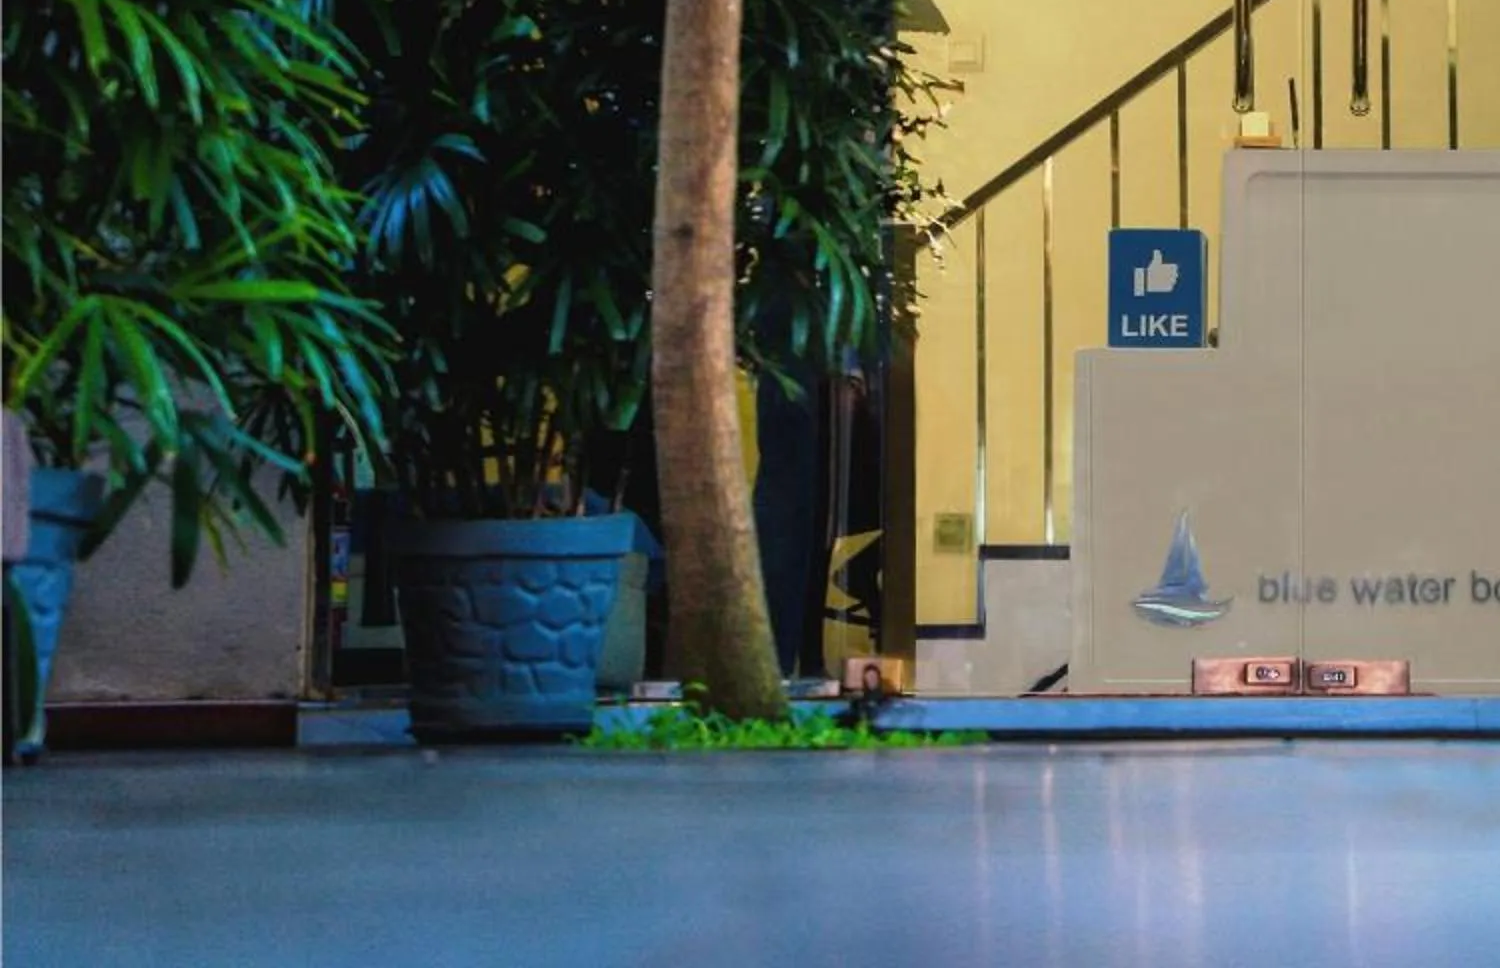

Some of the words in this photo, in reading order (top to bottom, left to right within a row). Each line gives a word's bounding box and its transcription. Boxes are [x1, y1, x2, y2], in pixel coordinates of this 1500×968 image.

[1121, 314, 1189, 337] LIKE
[1257, 571, 1337, 604] blue
[1350, 573, 1456, 605] water
